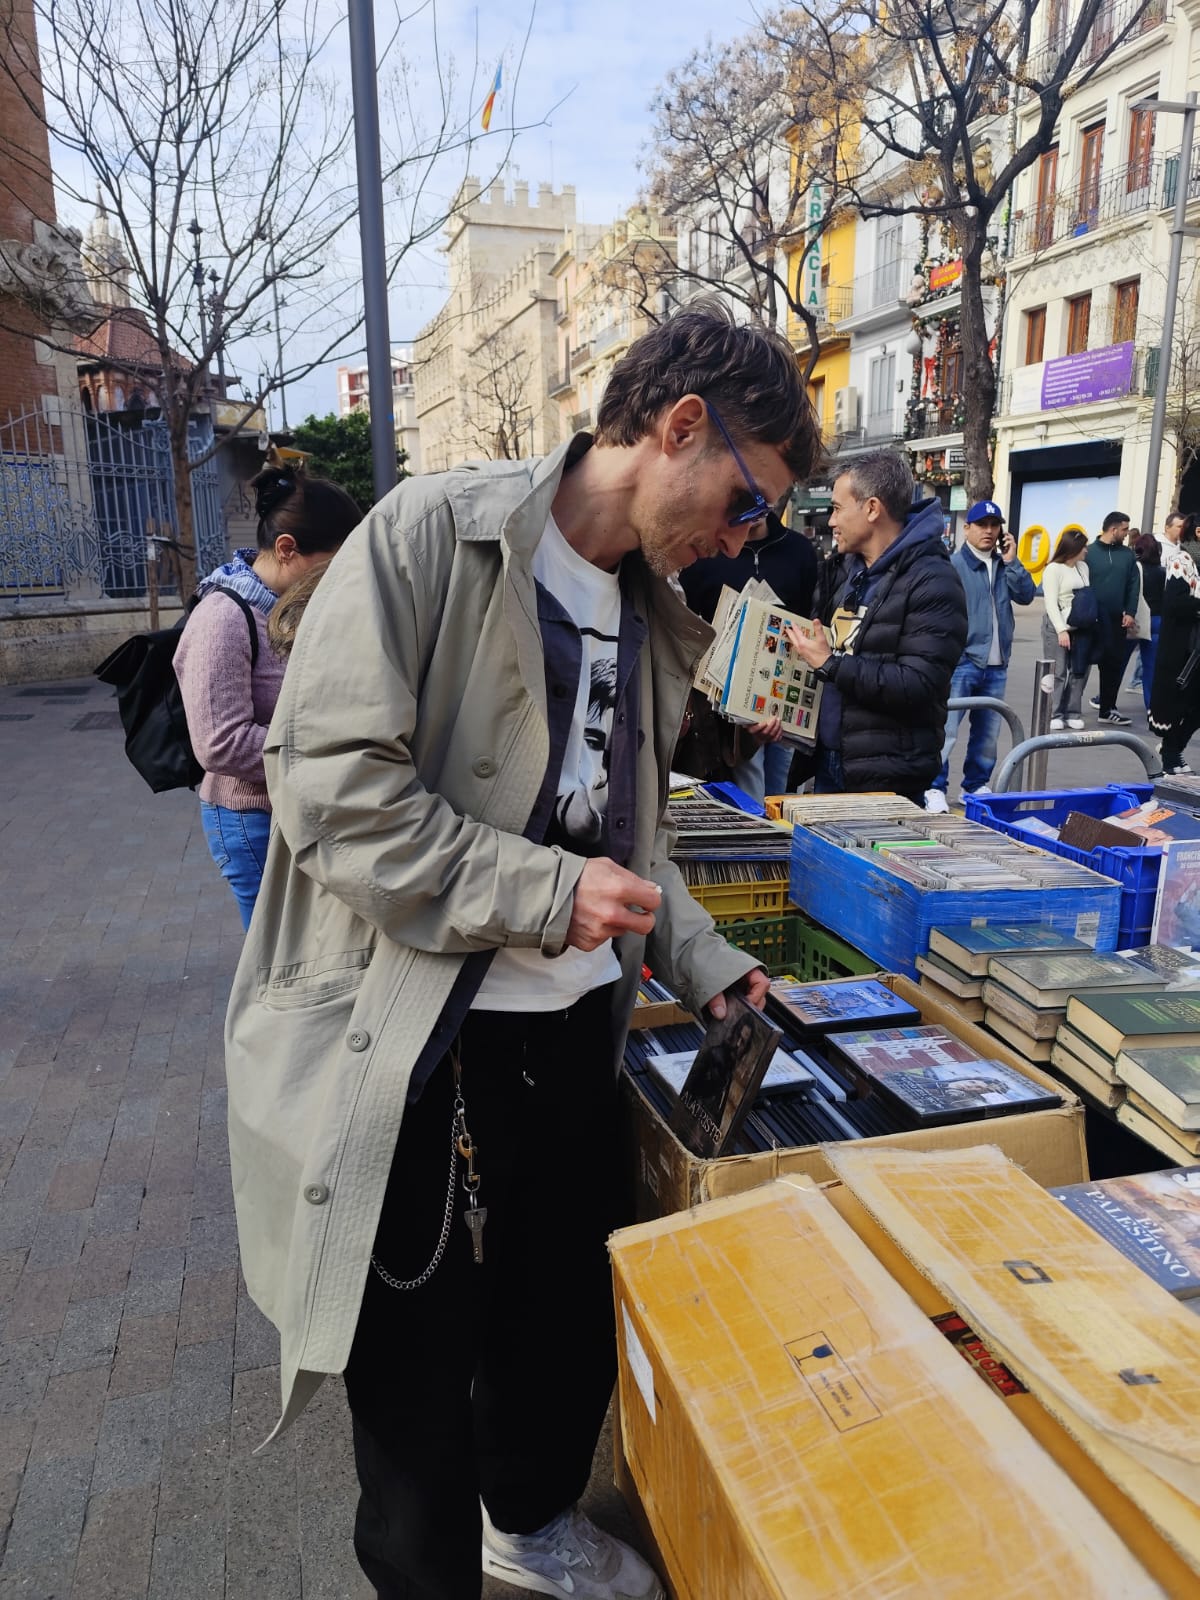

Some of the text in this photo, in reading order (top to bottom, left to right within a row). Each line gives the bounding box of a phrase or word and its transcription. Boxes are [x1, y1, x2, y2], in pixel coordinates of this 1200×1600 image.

[681, 1090, 722, 1145] ALATRISTE
[1085, 1190, 1190, 1278] PALESTINO
[1136, 1217, 1166, 1240] EL
